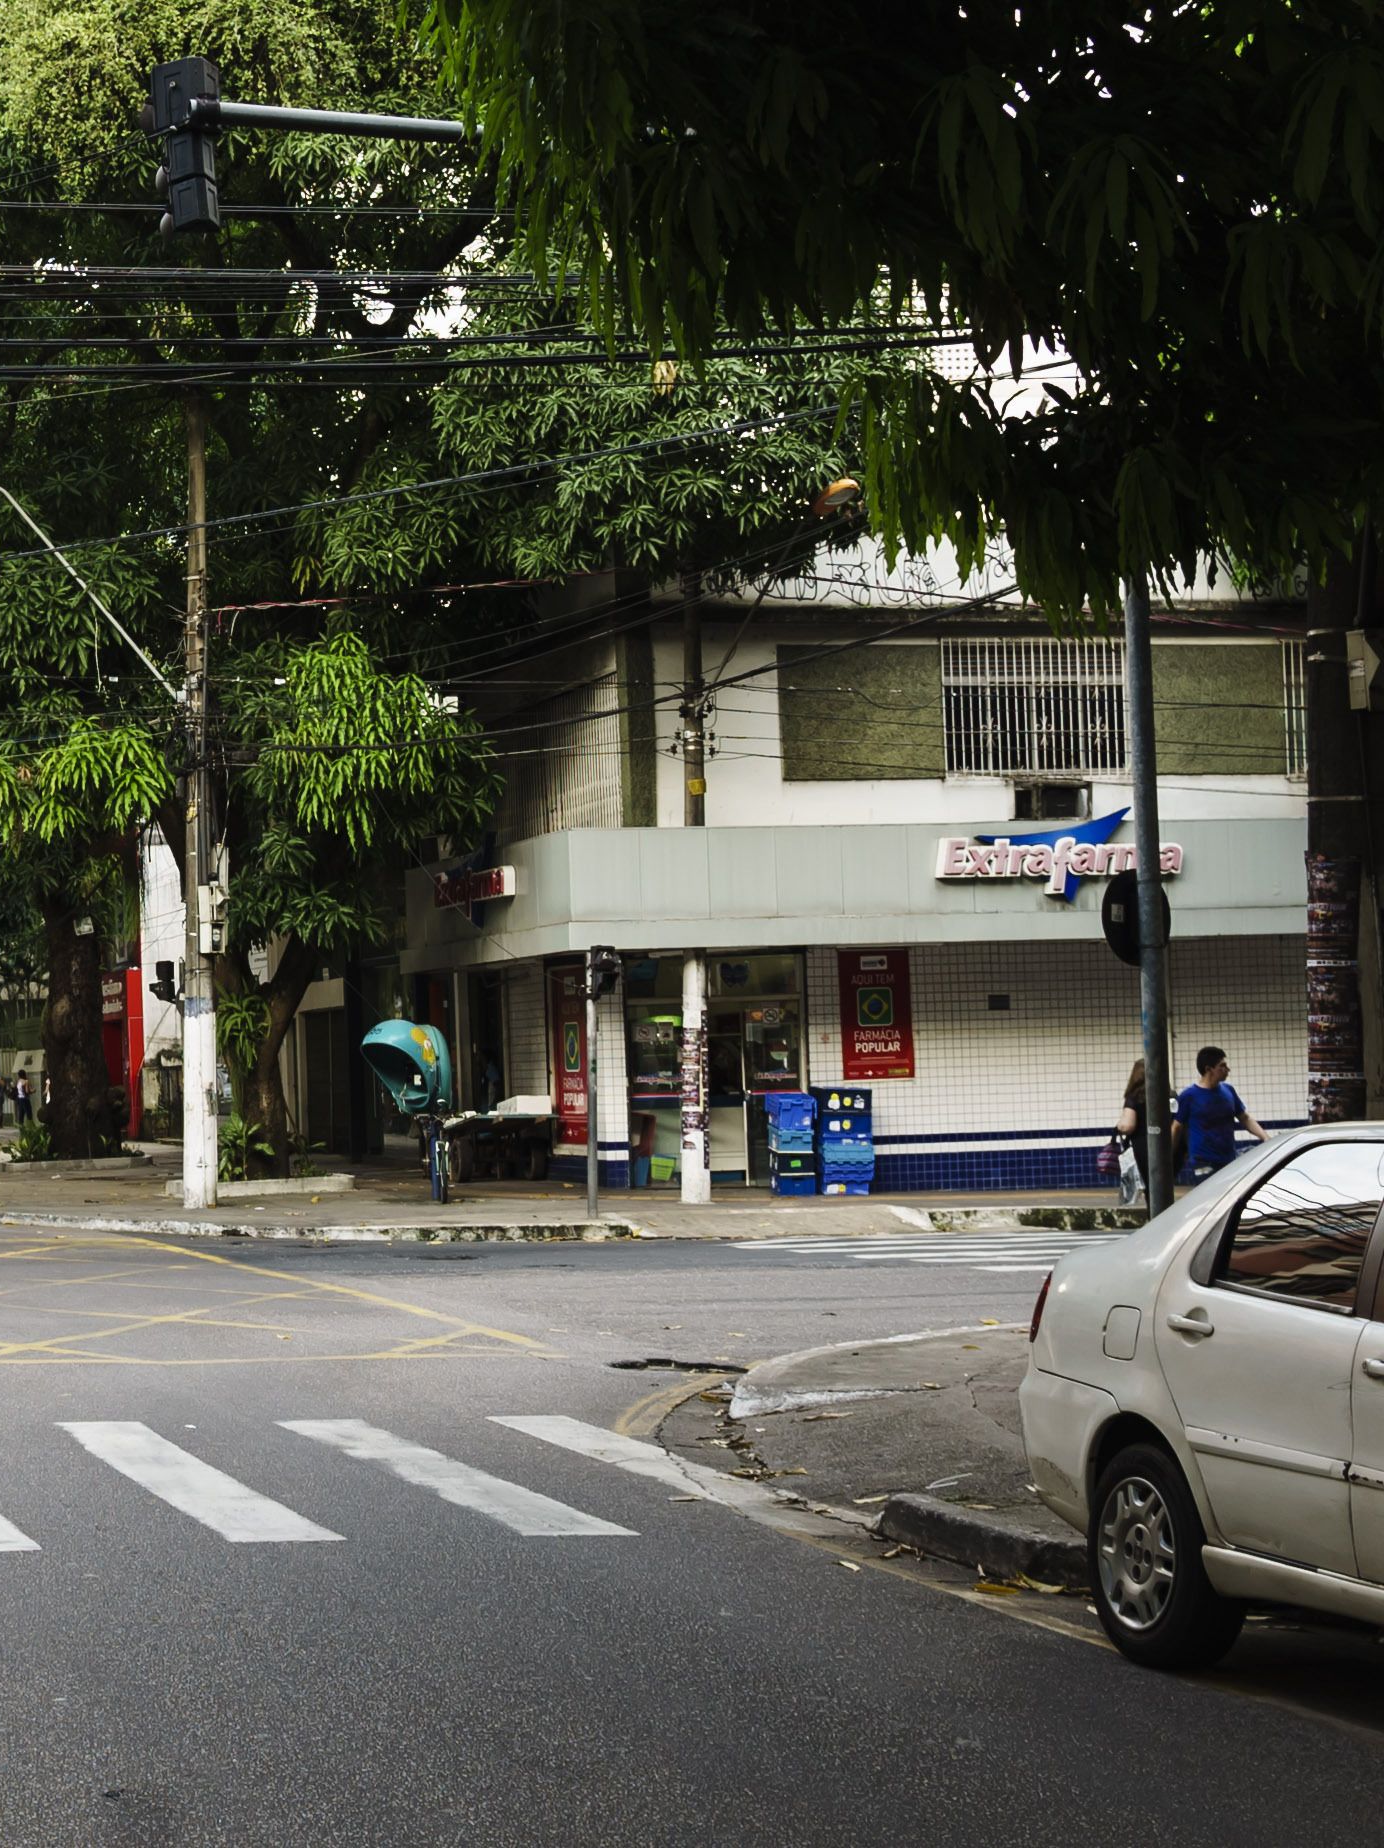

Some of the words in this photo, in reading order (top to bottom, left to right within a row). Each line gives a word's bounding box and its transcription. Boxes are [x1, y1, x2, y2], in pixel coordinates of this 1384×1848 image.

[851, 974, 873, 985] AQUI
[875, 973, 895, 984] TEM
[854, 1028, 901, 1041] FARMÁCIA
[855, 1041, 901, 1054] POPULAR
